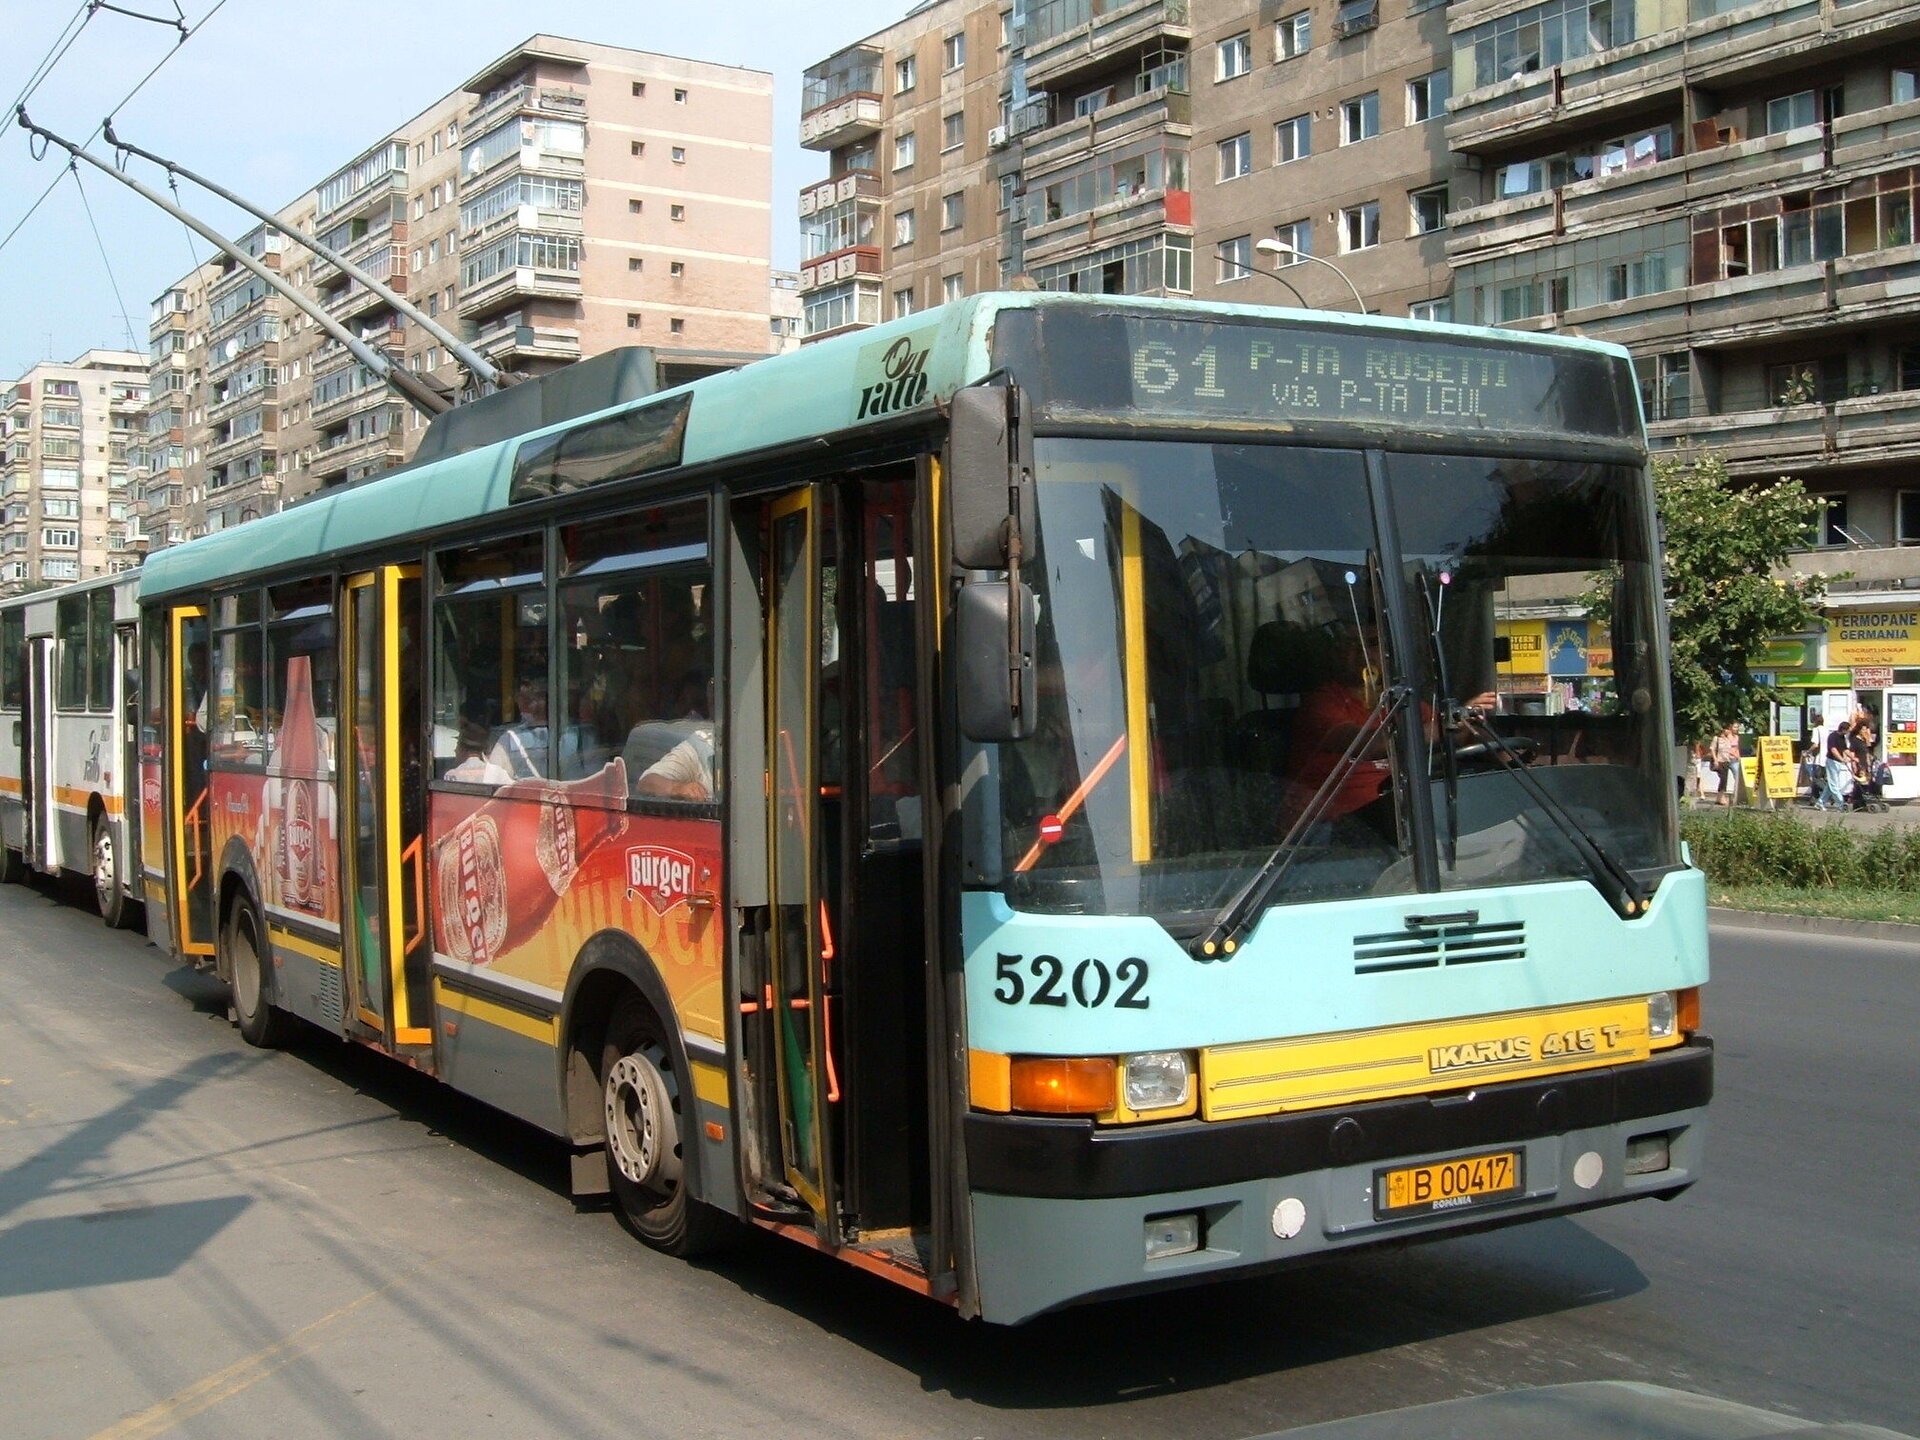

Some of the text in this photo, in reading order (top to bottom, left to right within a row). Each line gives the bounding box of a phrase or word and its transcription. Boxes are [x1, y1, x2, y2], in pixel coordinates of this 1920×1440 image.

[1134, 341, 1225, 398] 61
[1251, 340, 1508, 388] P-TA ROSETTI
[1272, 377, 1487, 418] via P-TA LEUL
[1833, 613, 1918, 627] TERMOPANE
[1840, 629, 1909, 641] GERMANIA
[630, 851, 692, 898] Bürger
[993, 952, 1150, 1010] 5202
[1428, 1024, 1621, 1074] IKARUS 415 T
[1414, 1156, 1509, 1202] B 00417
[1432, 1194, 1472, 1210] ROMANIA
